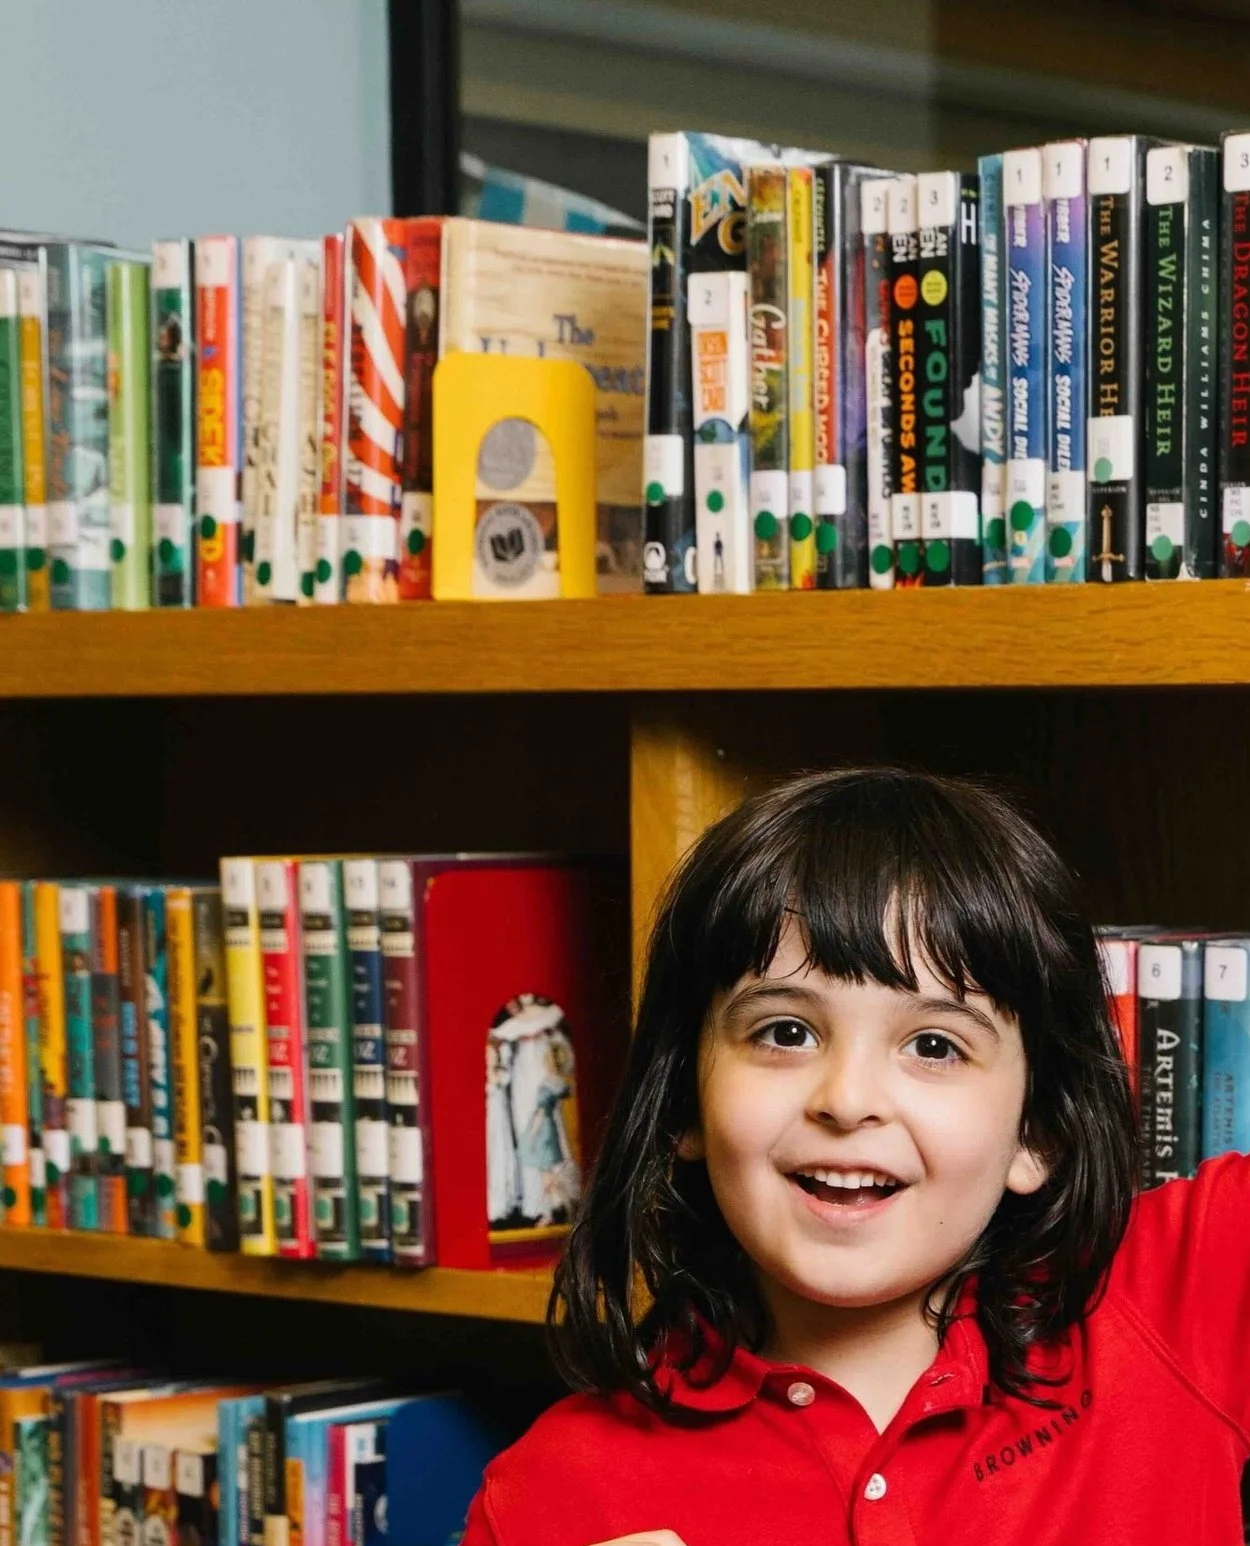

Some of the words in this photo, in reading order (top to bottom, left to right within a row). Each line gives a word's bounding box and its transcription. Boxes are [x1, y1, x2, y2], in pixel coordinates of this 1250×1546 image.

[1100, 196, 1115, 236] THE
[1158, 205, 1174, 249] THE
[1234, 192, 1249, 233] THE
[1099, 240, 1119, 374] WARRIOR
[1156, 253, 1178, 373] WIZARD
[899, 319, 917, 449] SECONDS
[923, 318, 947, 492] FOUND
[1013, 376, 1029, 432] SOCIAL
[1056, 374, 1072, 431] SOCIAL
[1200, 310, 1211, 430] WILLIAMS
[1156, 383, 1176, 456] HEIR
[974, 1389, 1093, 1483] BROWNING
